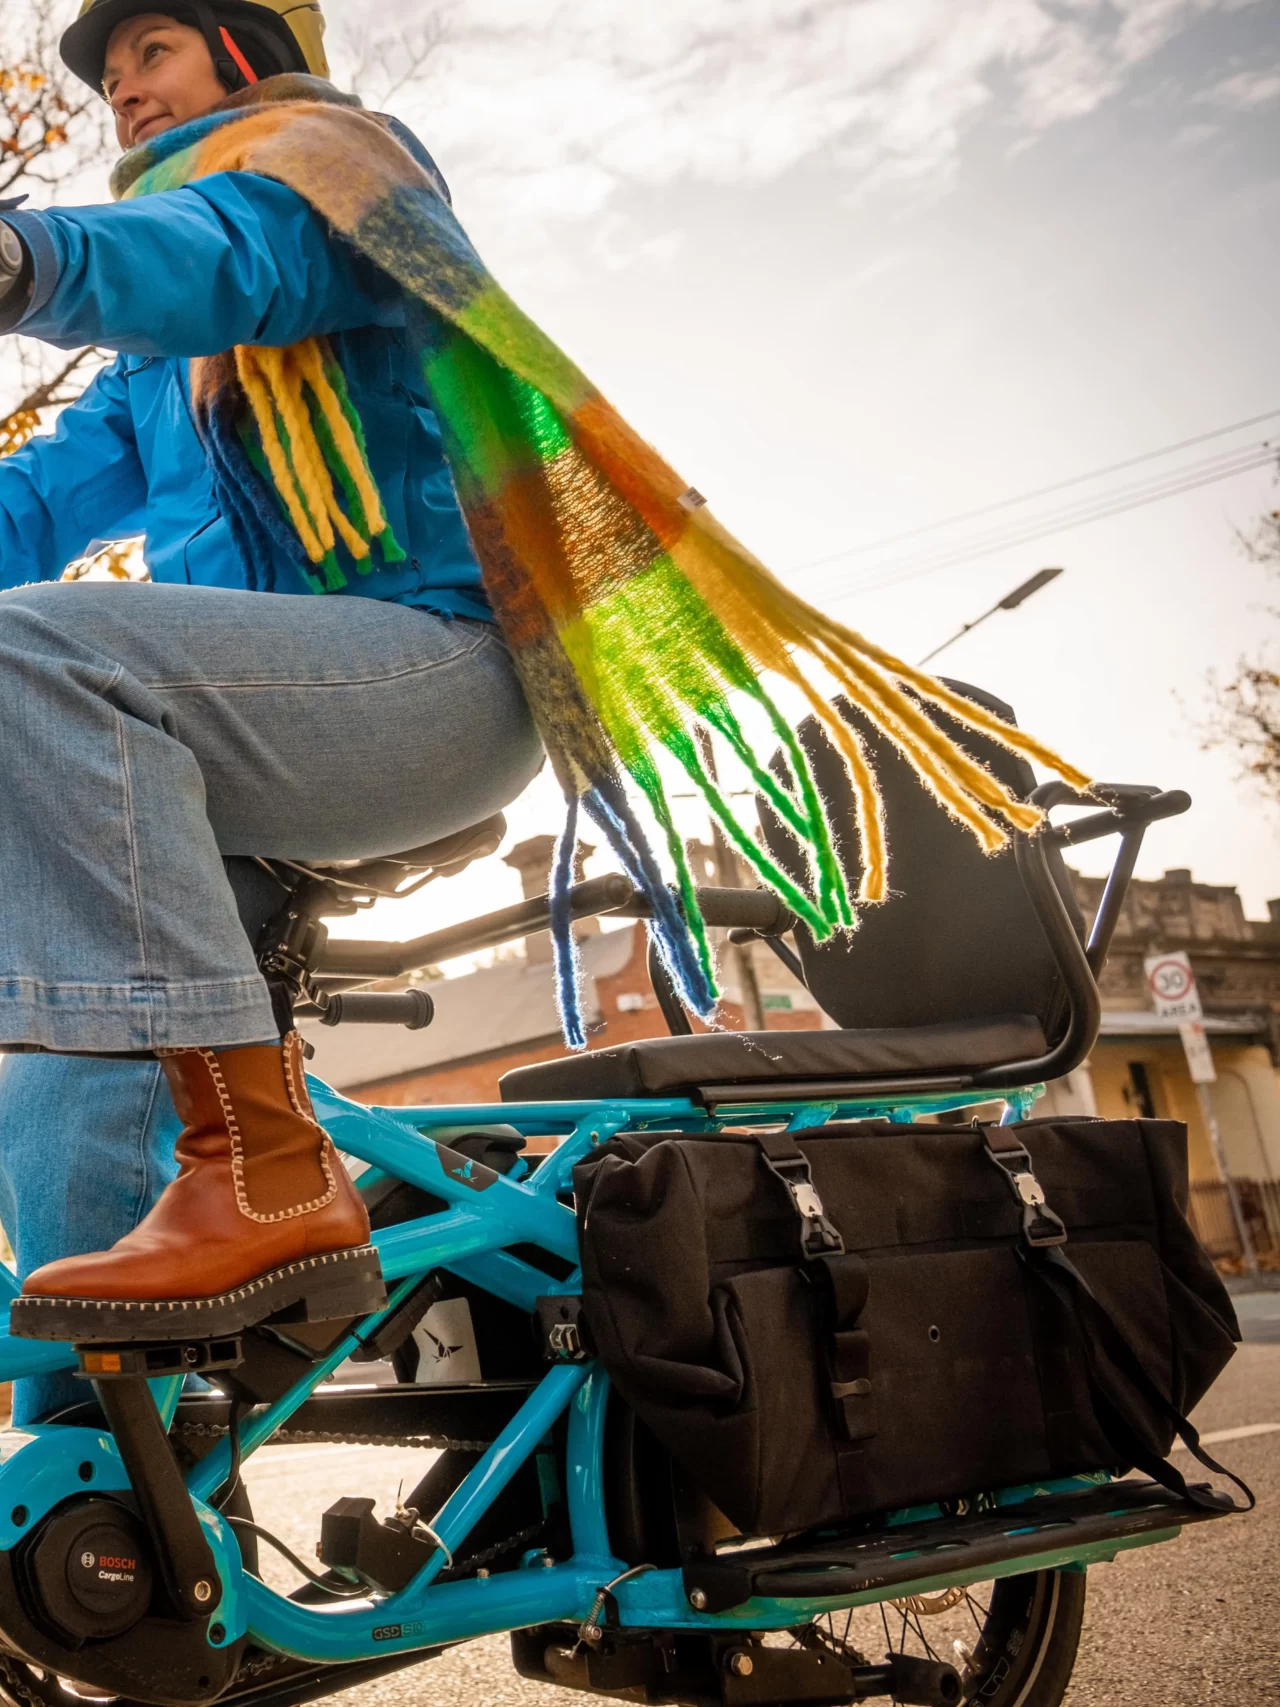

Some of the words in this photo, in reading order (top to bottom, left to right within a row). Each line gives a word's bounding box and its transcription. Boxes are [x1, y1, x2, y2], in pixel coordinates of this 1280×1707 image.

[1161, 1003, 1197, 1018] AREA
[99, 1555, 136, 1570] BOSCH
[98, 1570, 135, 1582] CargoLine
[374, 1626, 400, 1640] GSD
[403, 1622, 424, 1636] S10
